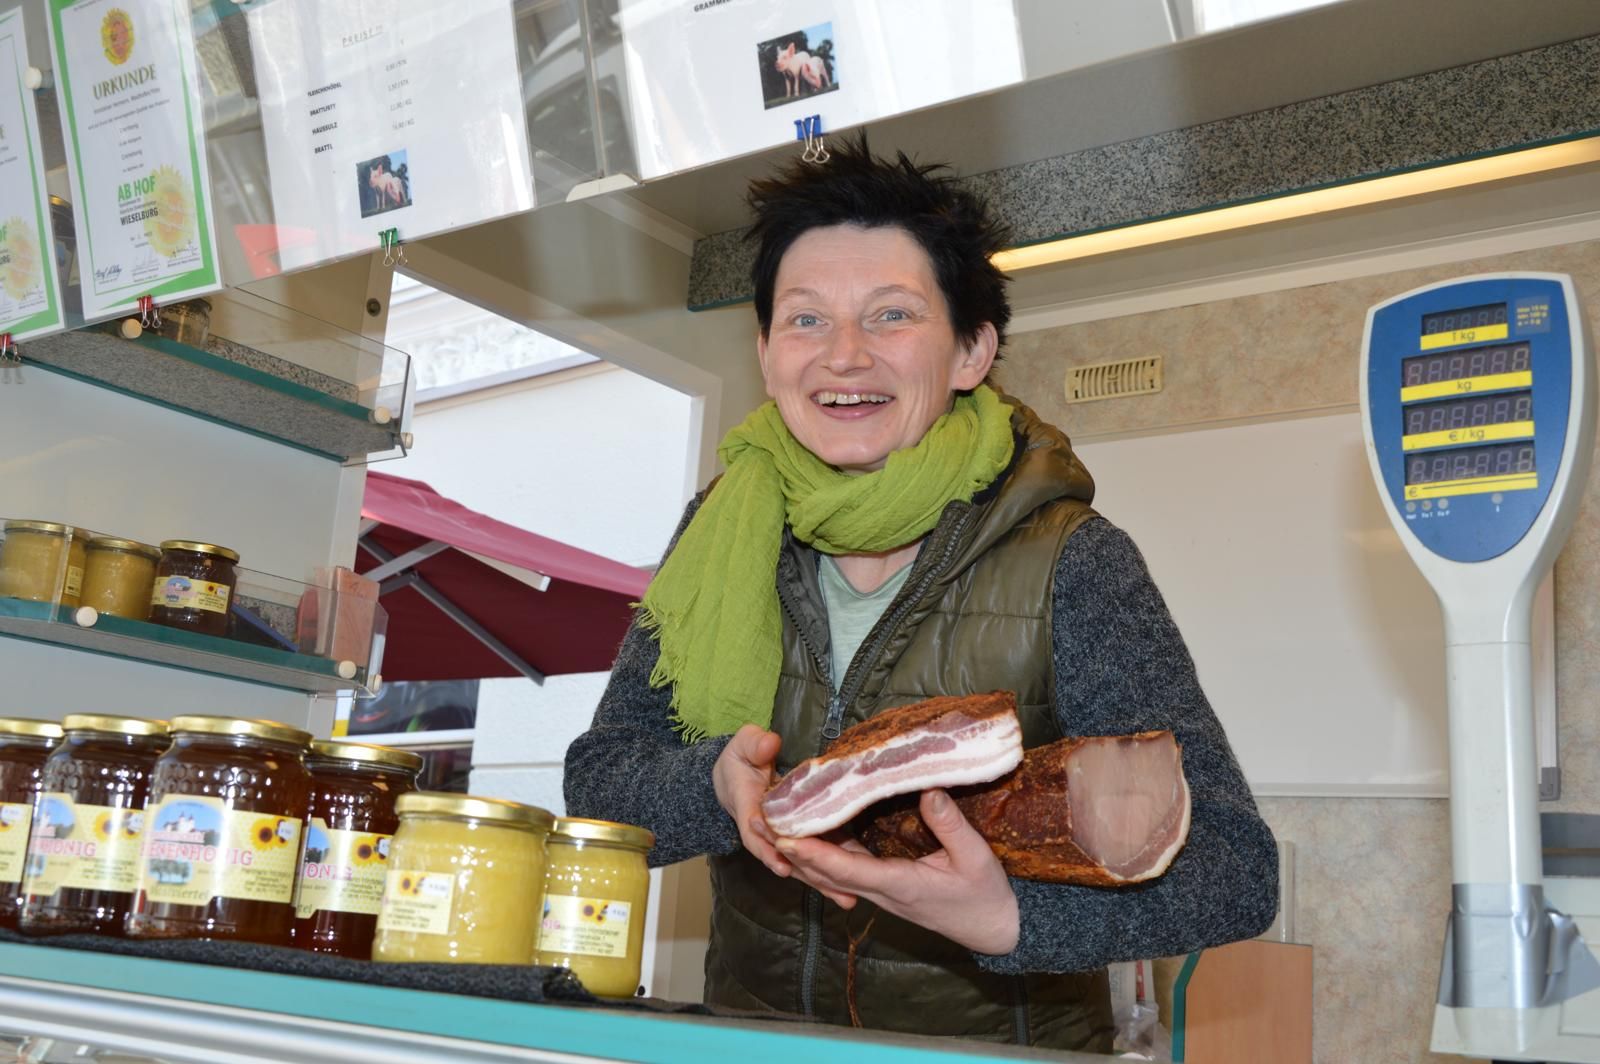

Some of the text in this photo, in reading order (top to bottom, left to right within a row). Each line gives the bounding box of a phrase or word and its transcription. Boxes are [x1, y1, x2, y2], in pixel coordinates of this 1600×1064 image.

[92, 64, 156, 101] URKUNDE
[314, 143, 333, 154] BRATTL
[117, 175, 156, 201] AB HOF
[120, 207, 159, 226] WIESELBURG
[1460, 330, 1476, 343] kg
[1457, 381, 1472, 394] kg
[1449, 431, 1459, 442] €
[1470, 428, 1485, 441] kg
[1409, 486, 1418, 498] €
